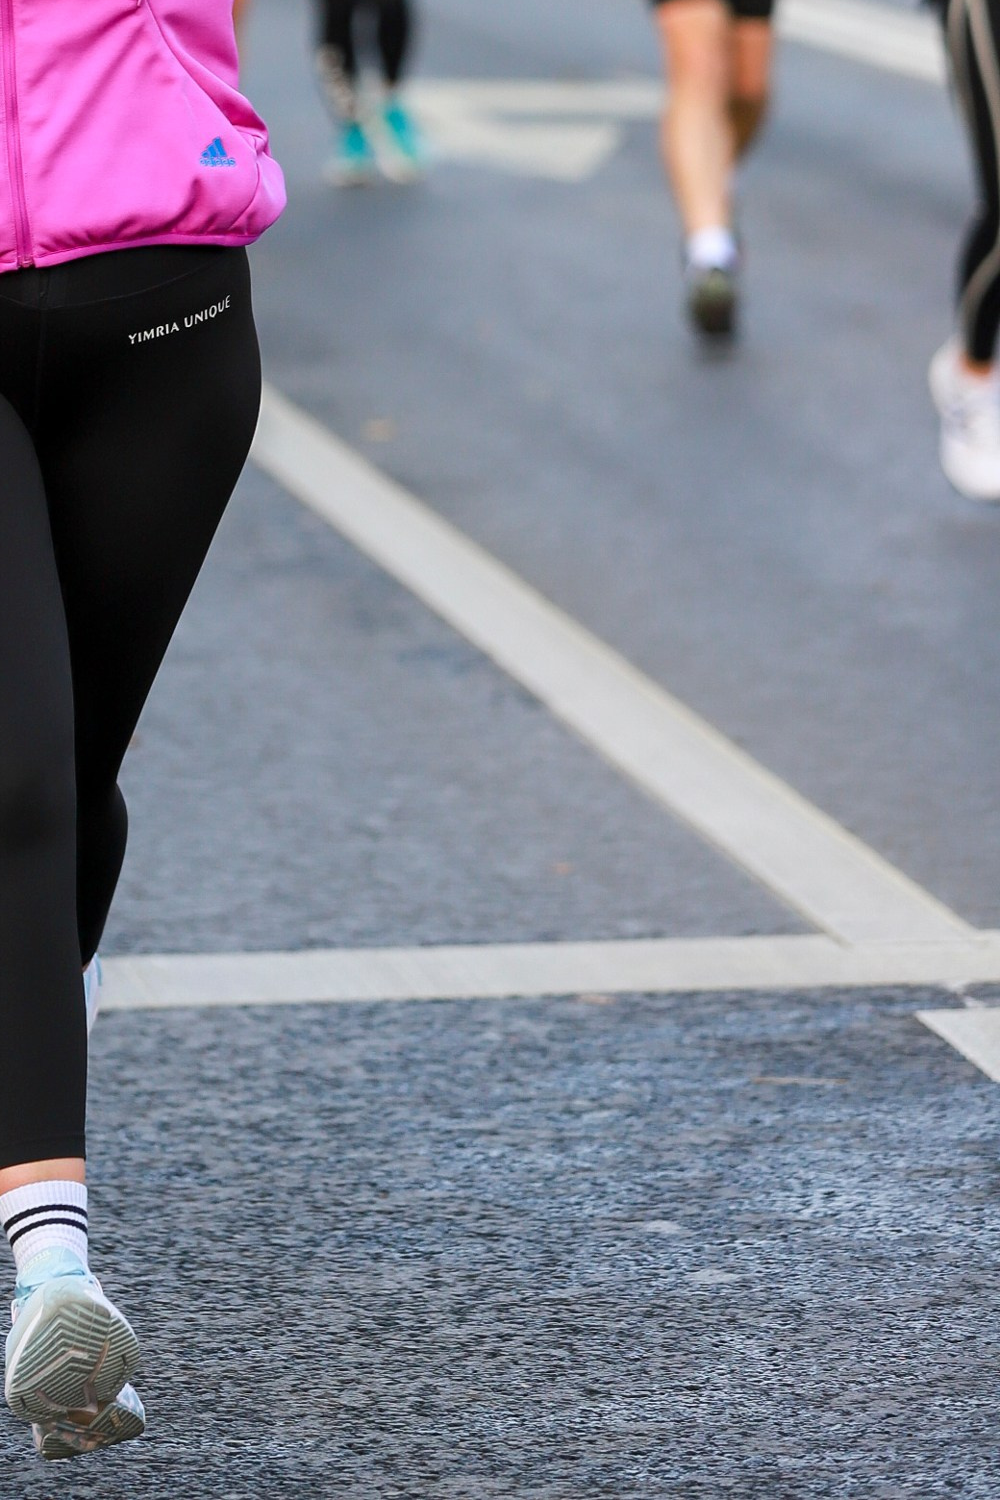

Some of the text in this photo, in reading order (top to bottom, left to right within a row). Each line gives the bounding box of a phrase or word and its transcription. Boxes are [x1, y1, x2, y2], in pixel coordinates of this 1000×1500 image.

[199, 157, 236, 167] adidas
[128, 295, 231, 345] YIMRIA UNIQUE
